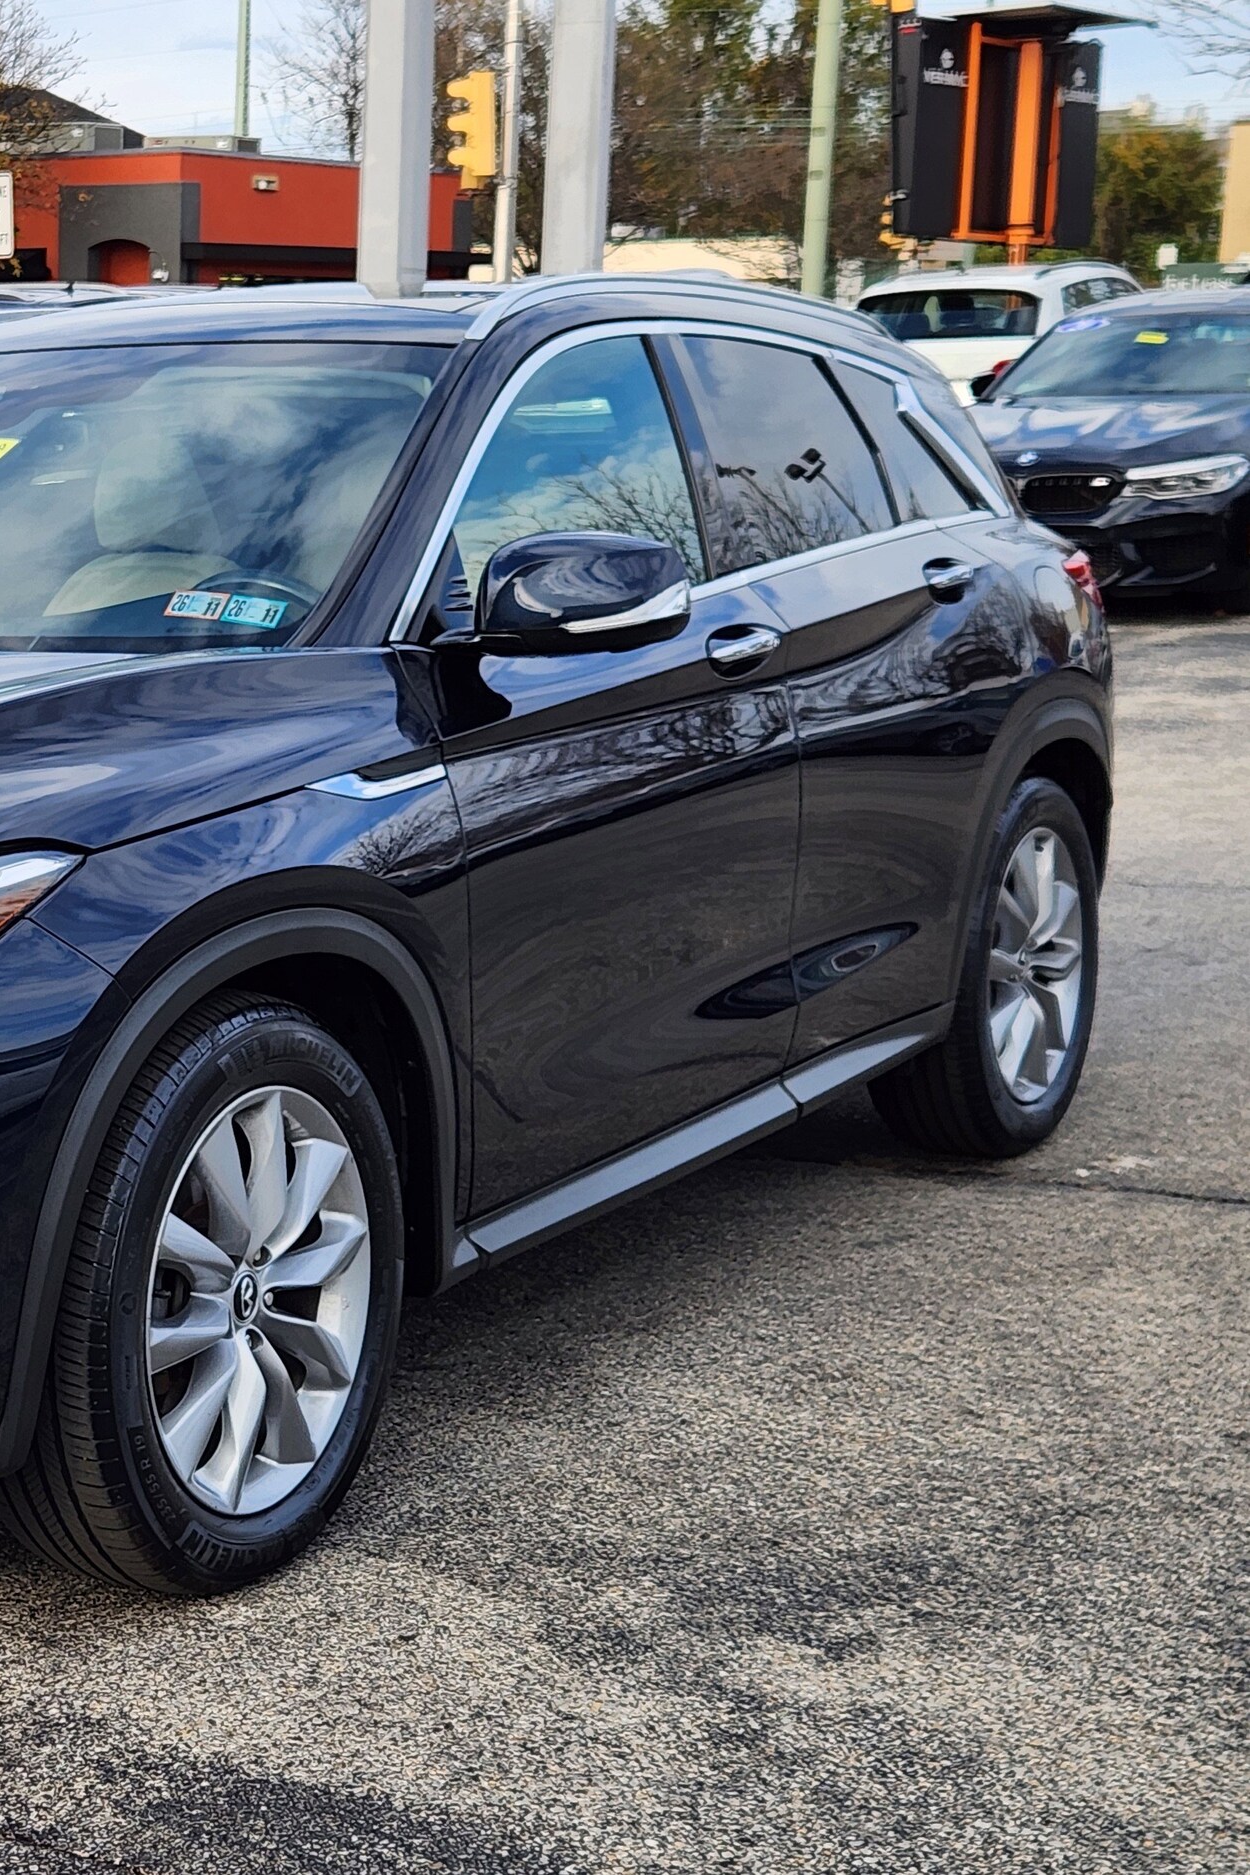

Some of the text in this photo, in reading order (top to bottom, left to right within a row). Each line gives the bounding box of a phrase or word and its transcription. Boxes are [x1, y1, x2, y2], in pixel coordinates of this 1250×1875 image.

[171, 594, 221, 617] 26 11
[228, 600, 280, 623] 26 11
[269, 1036, 360, 1090] MICHELIN
[134, 1434, 176, 1520] 235/55 R 19
